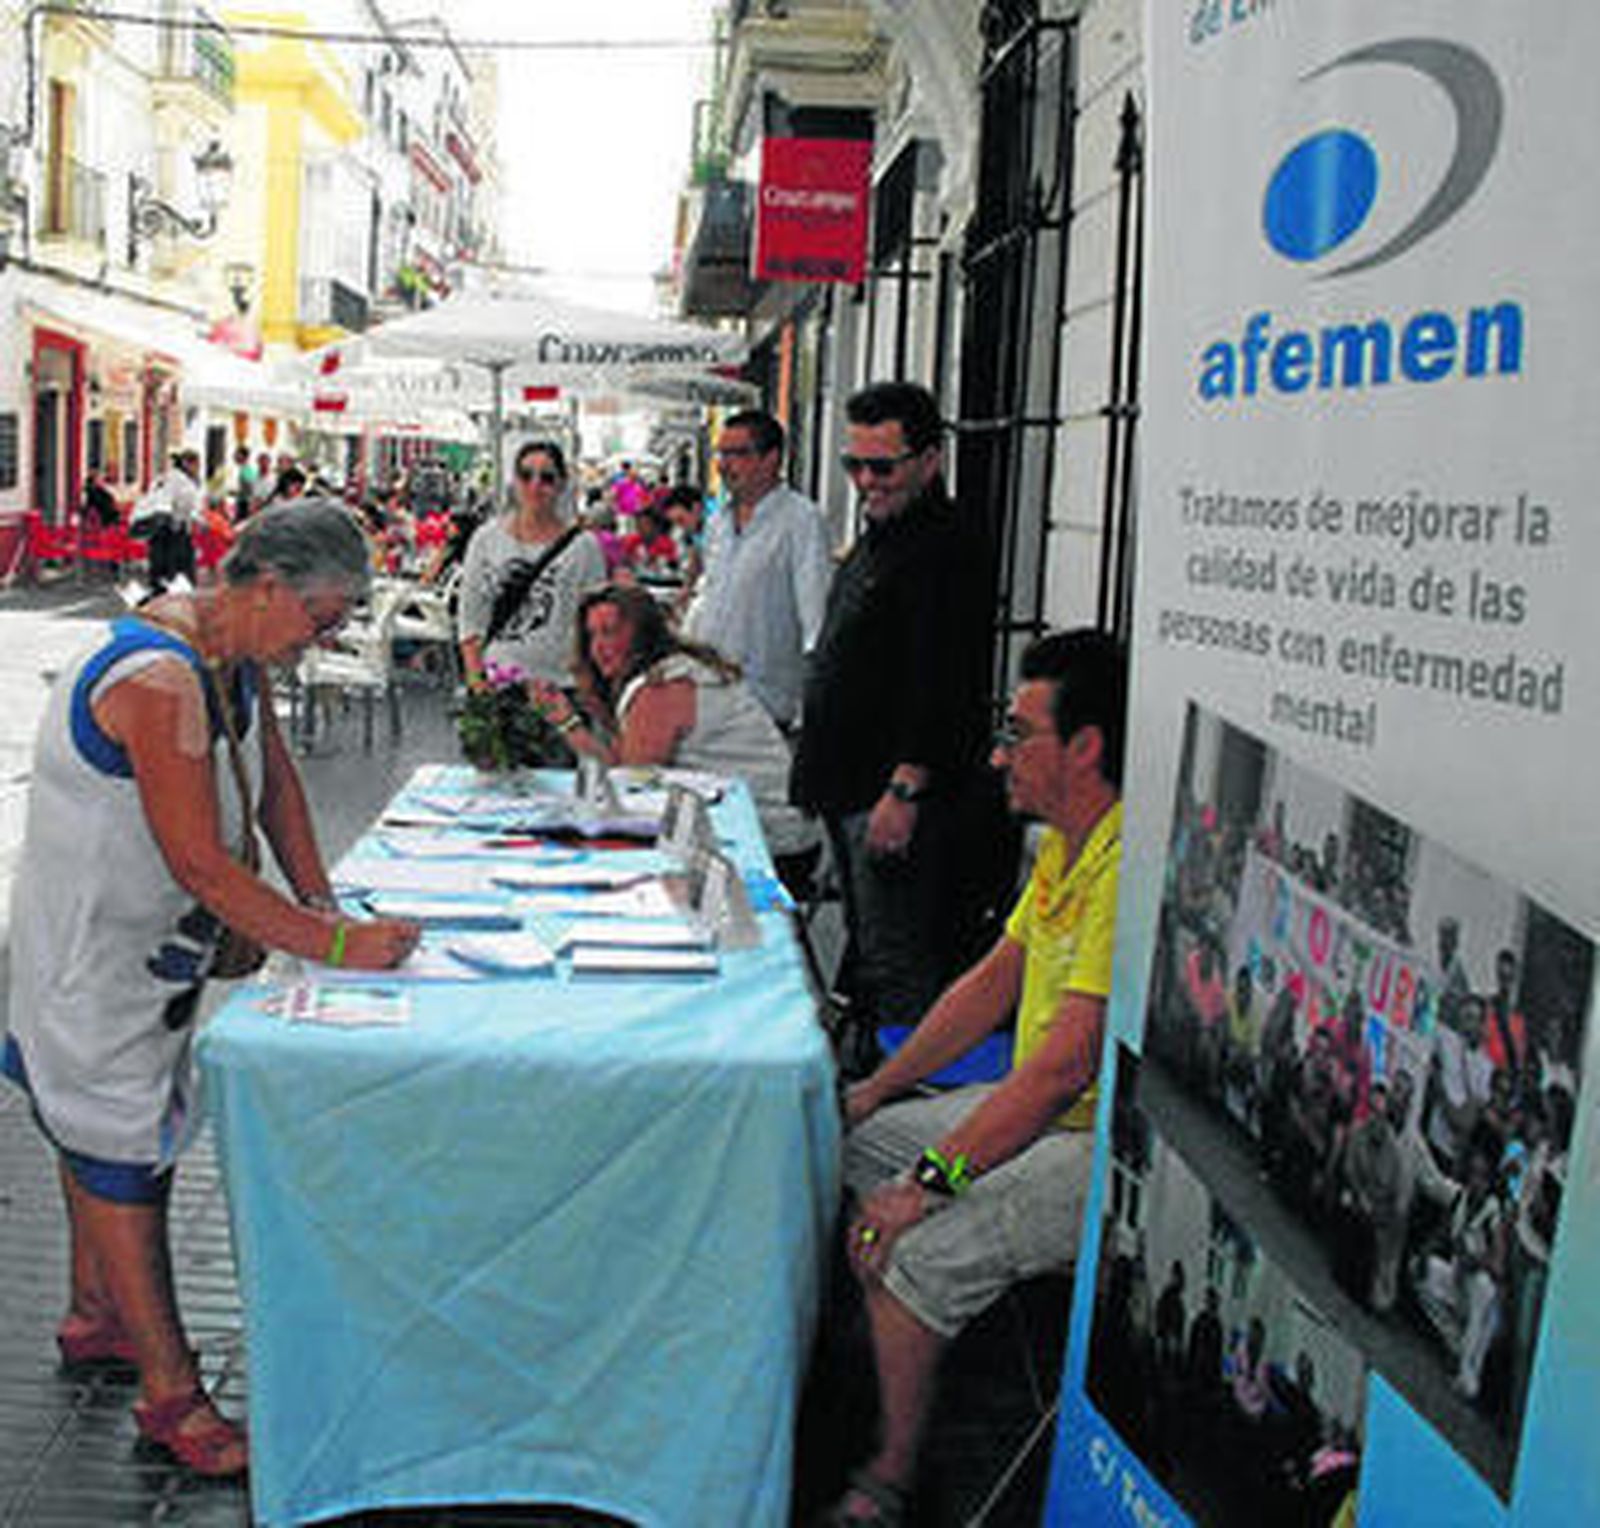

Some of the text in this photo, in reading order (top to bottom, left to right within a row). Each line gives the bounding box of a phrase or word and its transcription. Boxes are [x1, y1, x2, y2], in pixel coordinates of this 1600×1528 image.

[1199, 301, 1524, 401] afemen
[1178, 487, 1549, 549] Tratamos de mejorar la
[1185, 550, 1526, 624] calidad de vida de las
[1158, 609, 1564, 714] personas con enfermedad
[1269, 693, 1377, 746] mental
